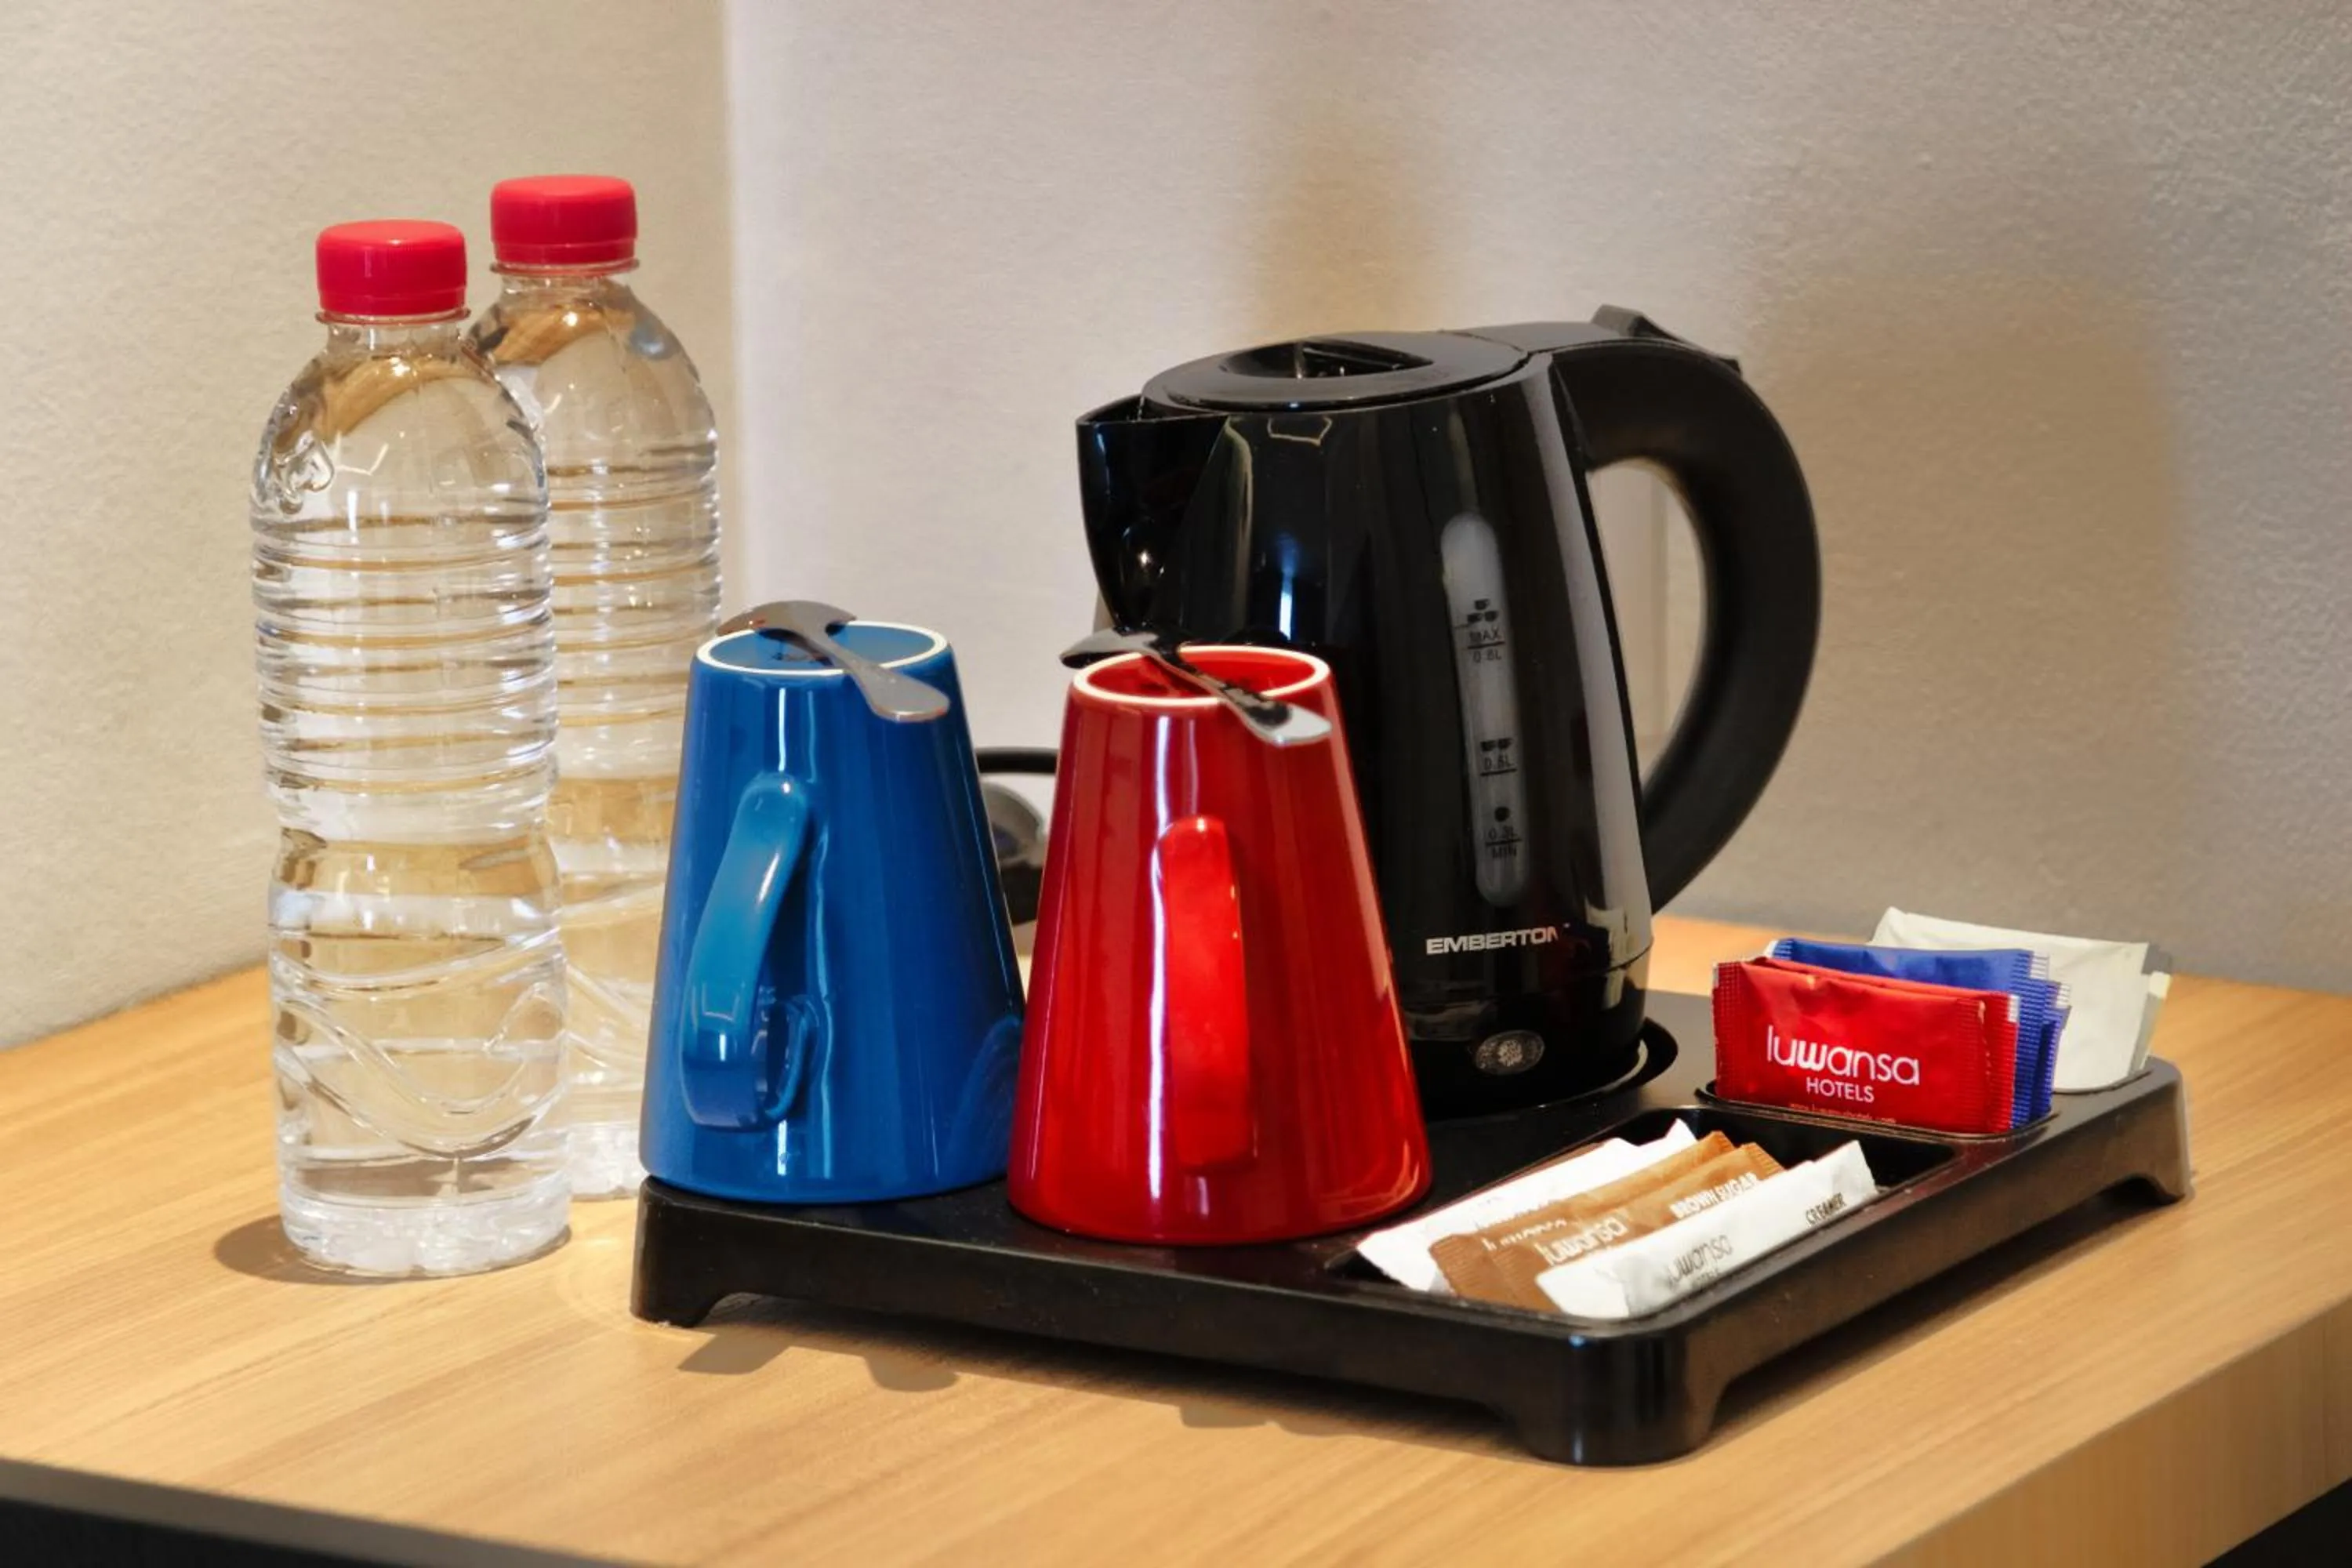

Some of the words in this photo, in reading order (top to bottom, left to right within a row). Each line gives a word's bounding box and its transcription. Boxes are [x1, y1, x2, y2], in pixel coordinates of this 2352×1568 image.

[1468, 627, 1501, 643] MAX
[1425, 926, 1559, 956] EMBERTON
[1767, 1025, 1920, 1086] luwansa
[1806, 1076, 1875, 1103] HOTELS
